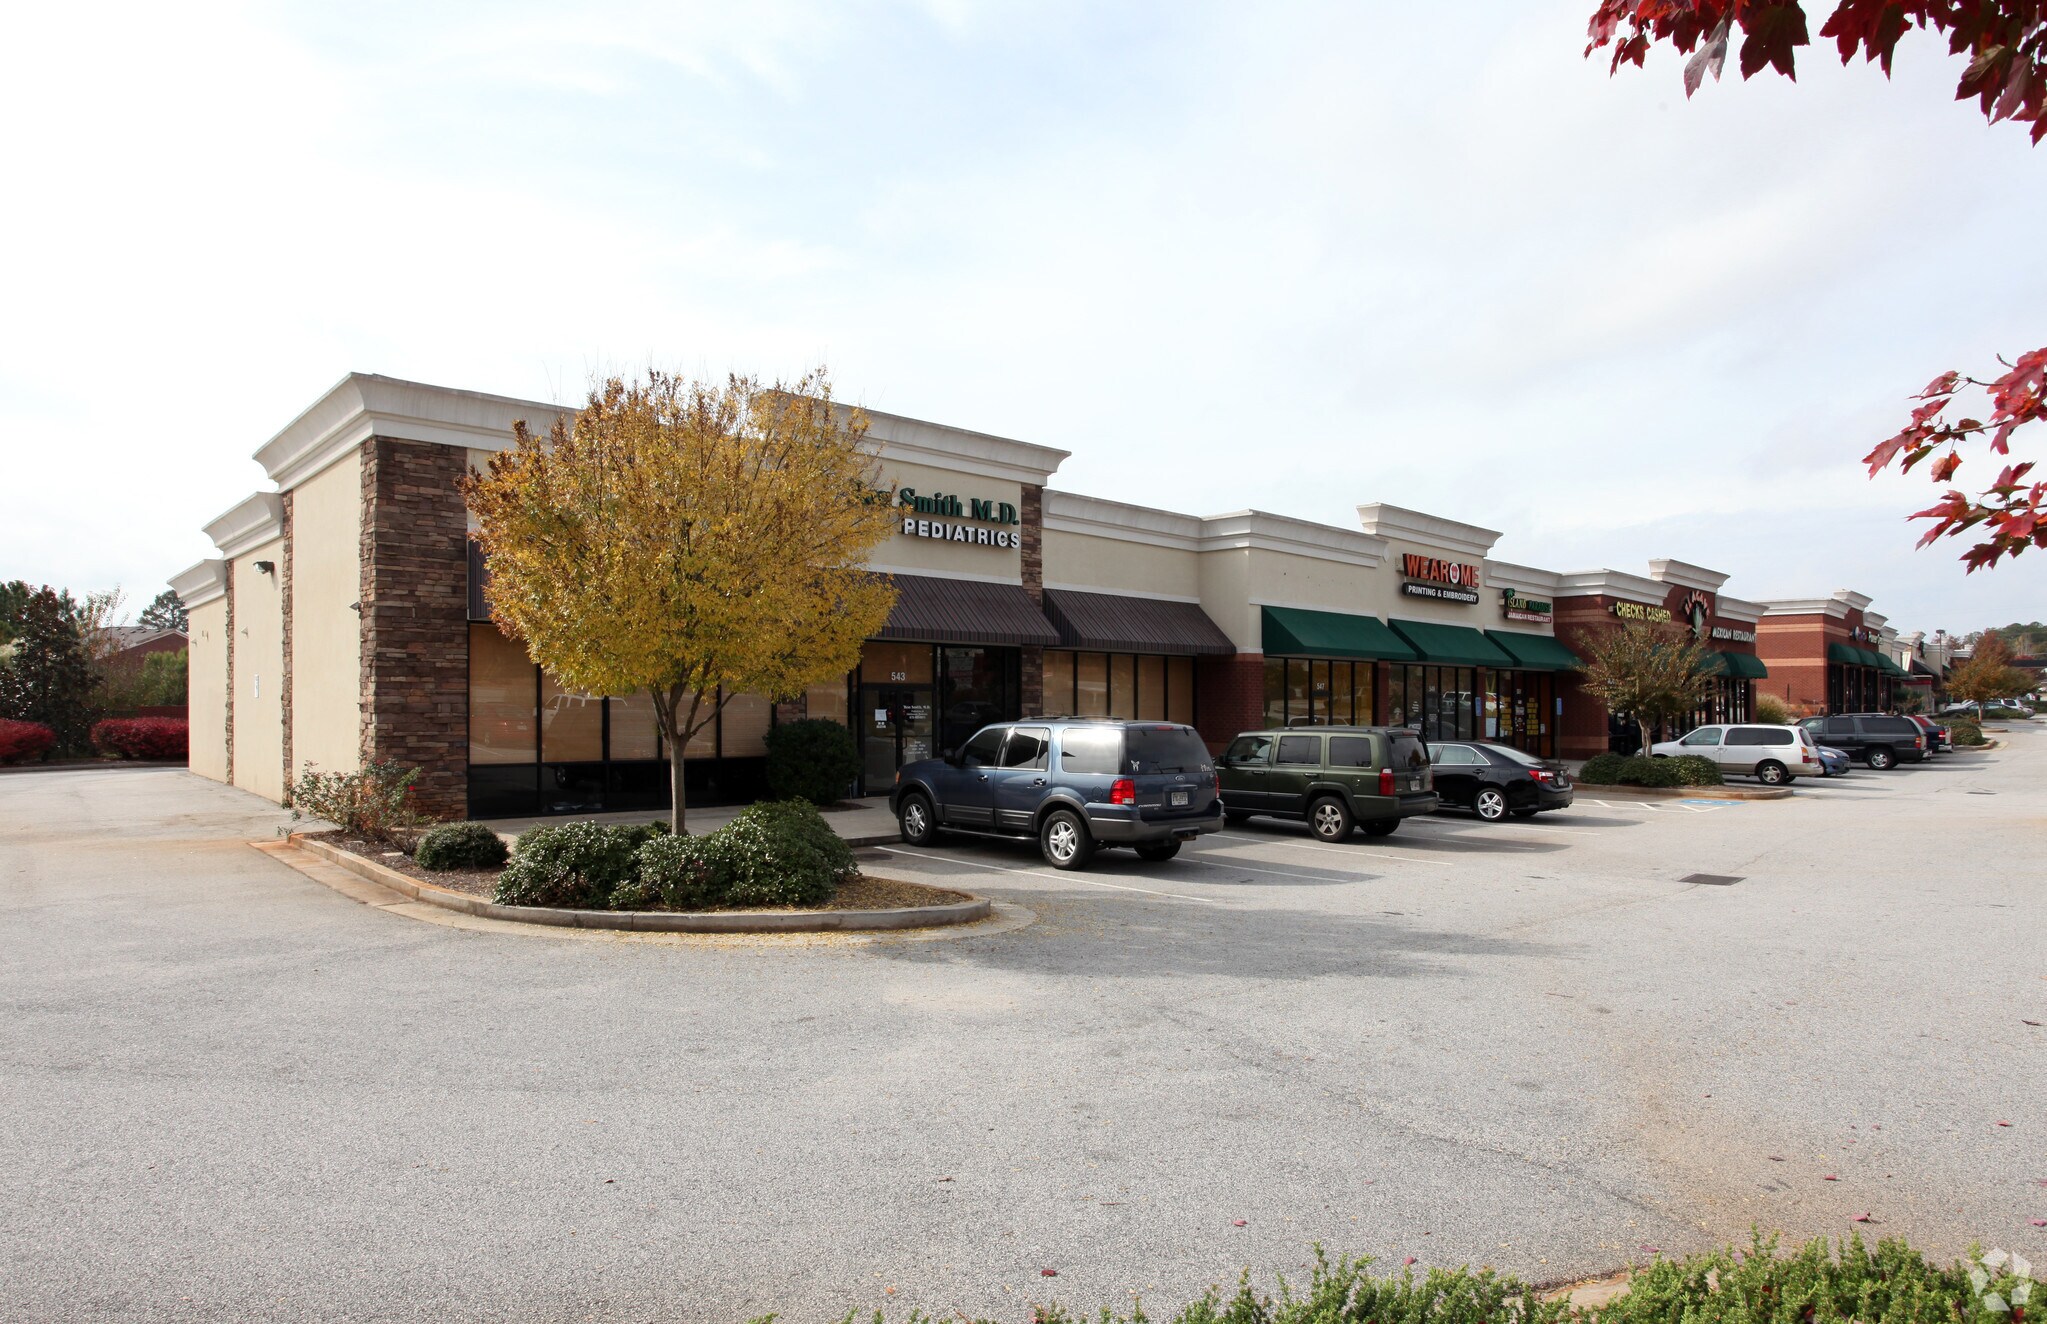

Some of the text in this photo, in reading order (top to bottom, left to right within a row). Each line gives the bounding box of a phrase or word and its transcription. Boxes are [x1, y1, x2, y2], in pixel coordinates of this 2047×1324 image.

[900, 487, 963, 517] Smith
[971, 497, 1019, 525] M.D.
[903, 518, 1020, 549] PEDIATRICS
[1408, 585, 1436, 597] PRINTING
[1437, 587, 1442, 598] &
[1443, 589, 1478, 603] EMBROIDERY
[1616, 601, 1672, 624] CHECKS CASHED
[891, 671, 906, 681] 543
